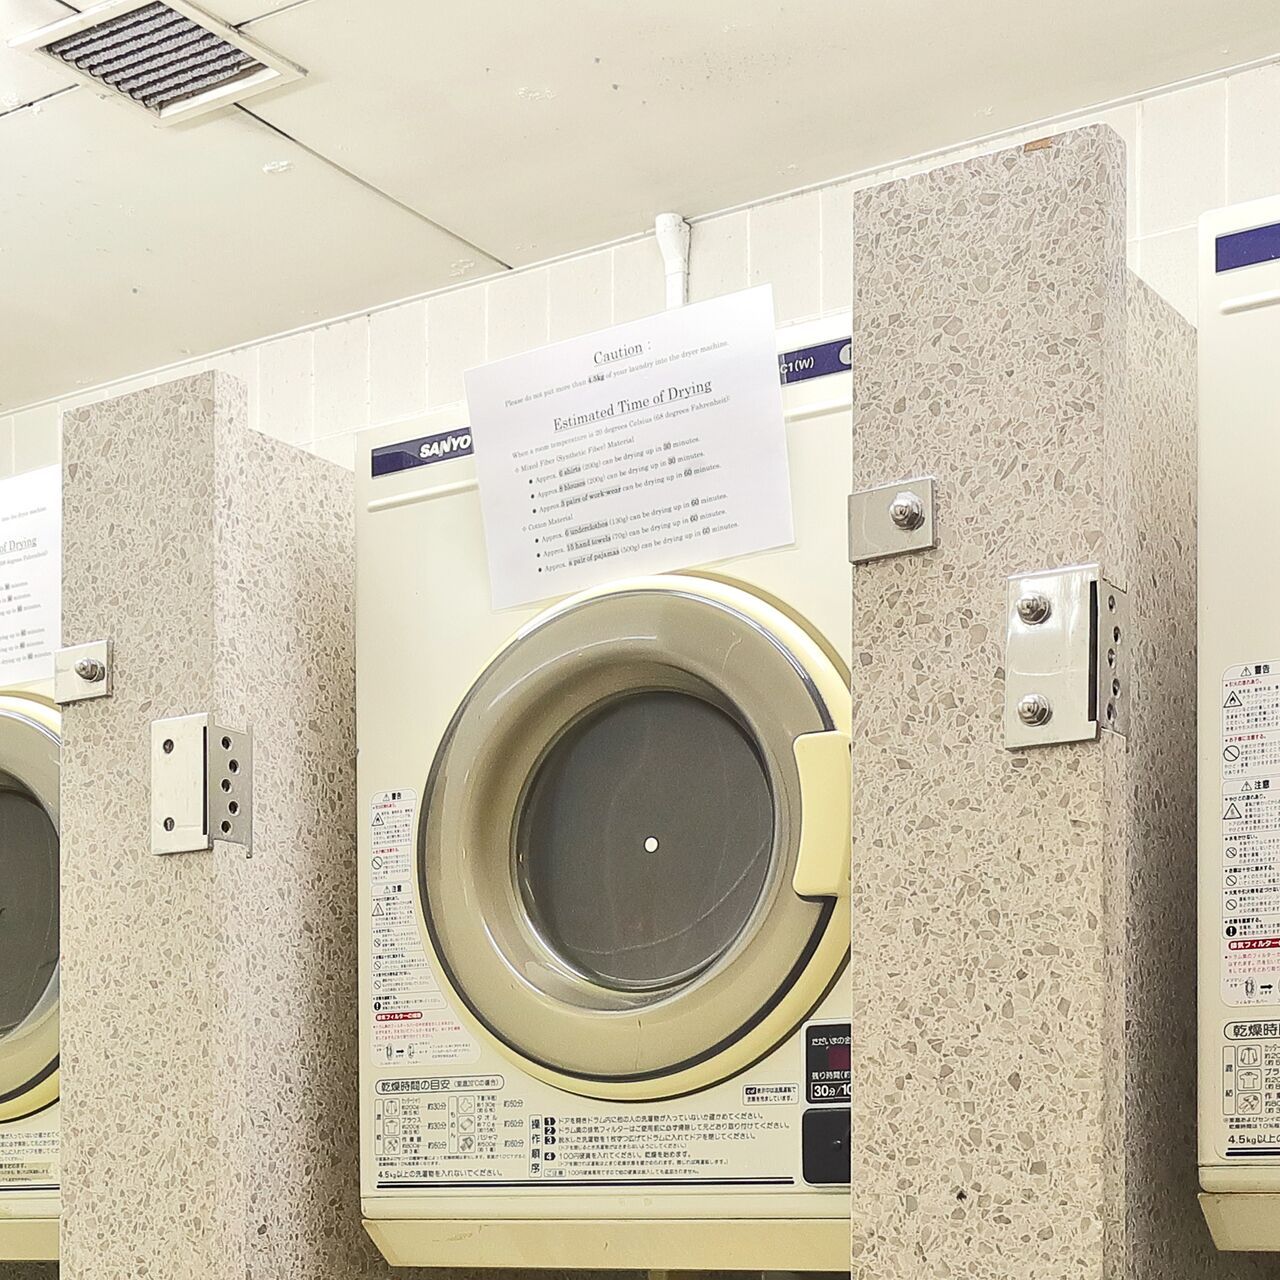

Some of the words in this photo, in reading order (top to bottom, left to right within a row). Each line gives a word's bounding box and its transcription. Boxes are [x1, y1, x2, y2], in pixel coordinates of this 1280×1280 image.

[593, 342, 644, 366] Caution
[553, 403, 614, 430] Estimated
[617, 397, 650, 413] Time
[652, 388, 665, 403] of
[668, 380, 713, 400] Drying
[419, 434, 472, 459] SANYO
[9, 537, 37, 552] Drying
